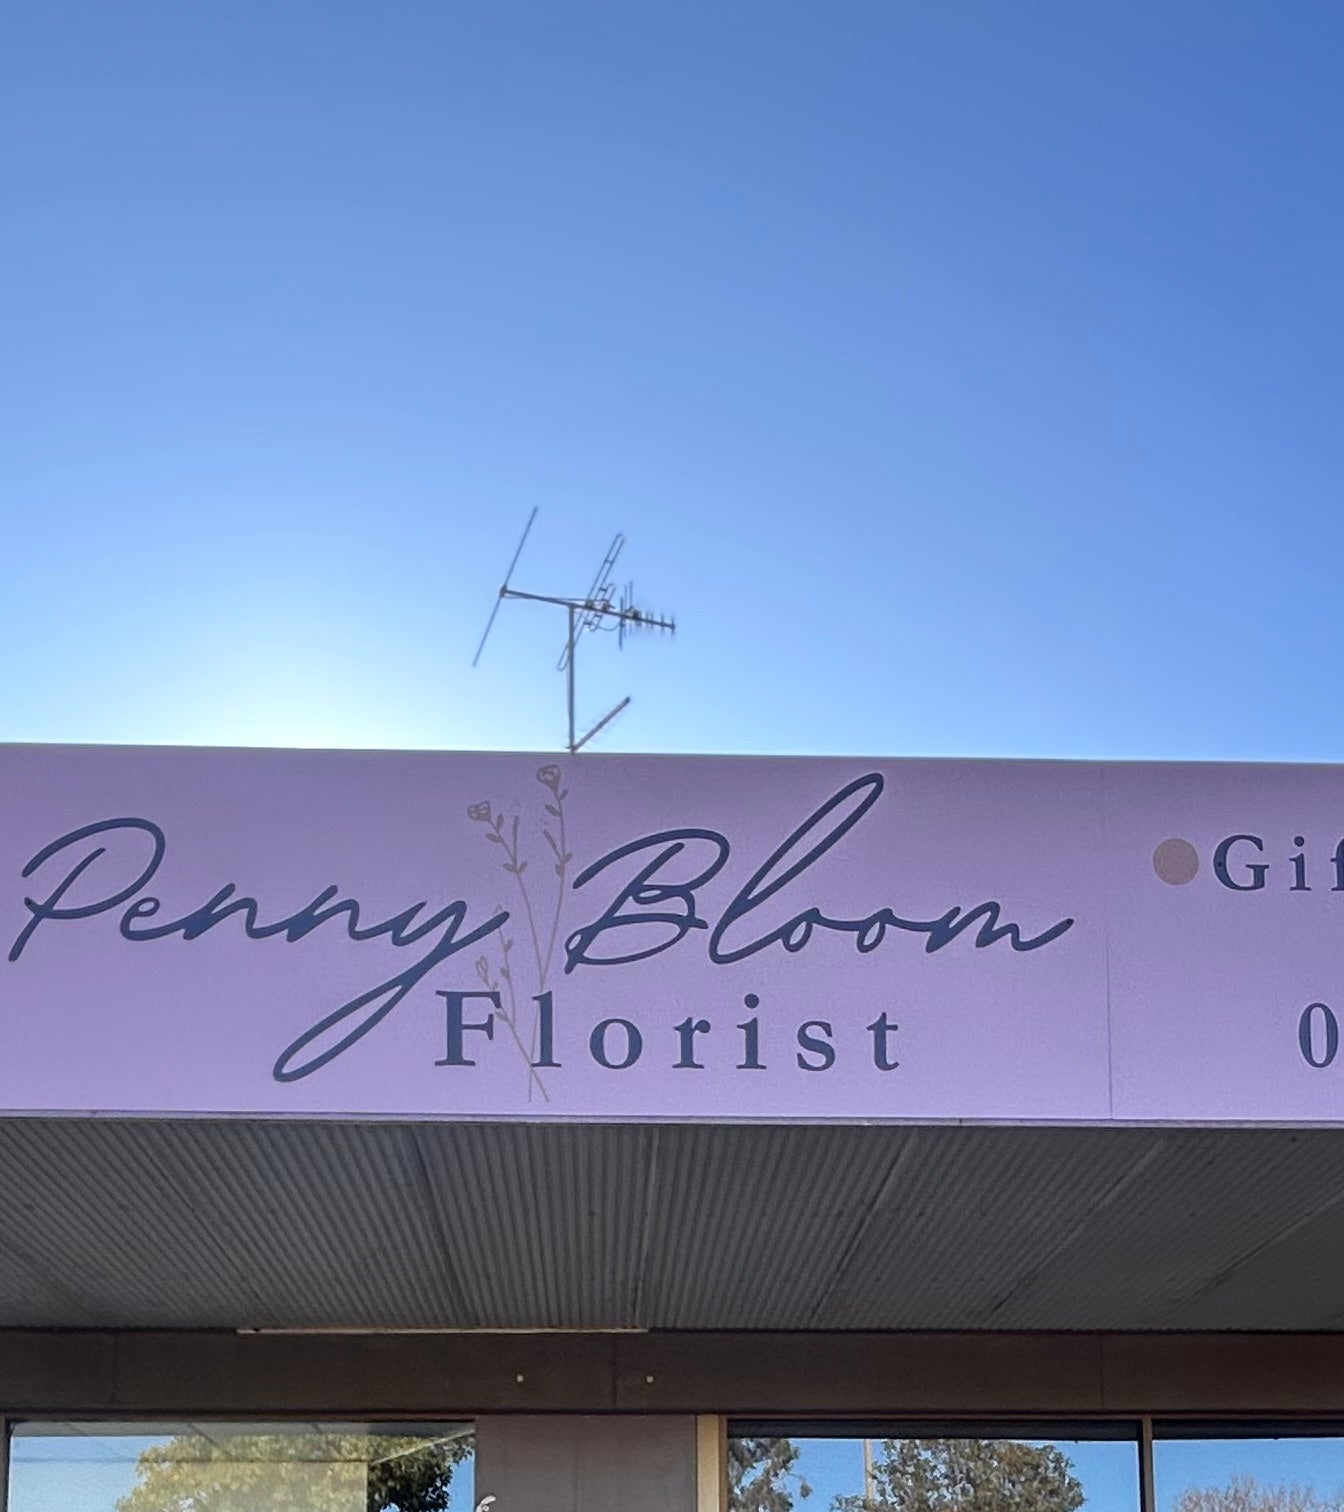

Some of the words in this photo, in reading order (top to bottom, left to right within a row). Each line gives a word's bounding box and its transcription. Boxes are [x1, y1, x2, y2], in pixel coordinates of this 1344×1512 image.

[8, 816, 510, 1084] Penny
[563, 771, 1076, 976] Bloom
[433, 988, 901, 1073] Florist
